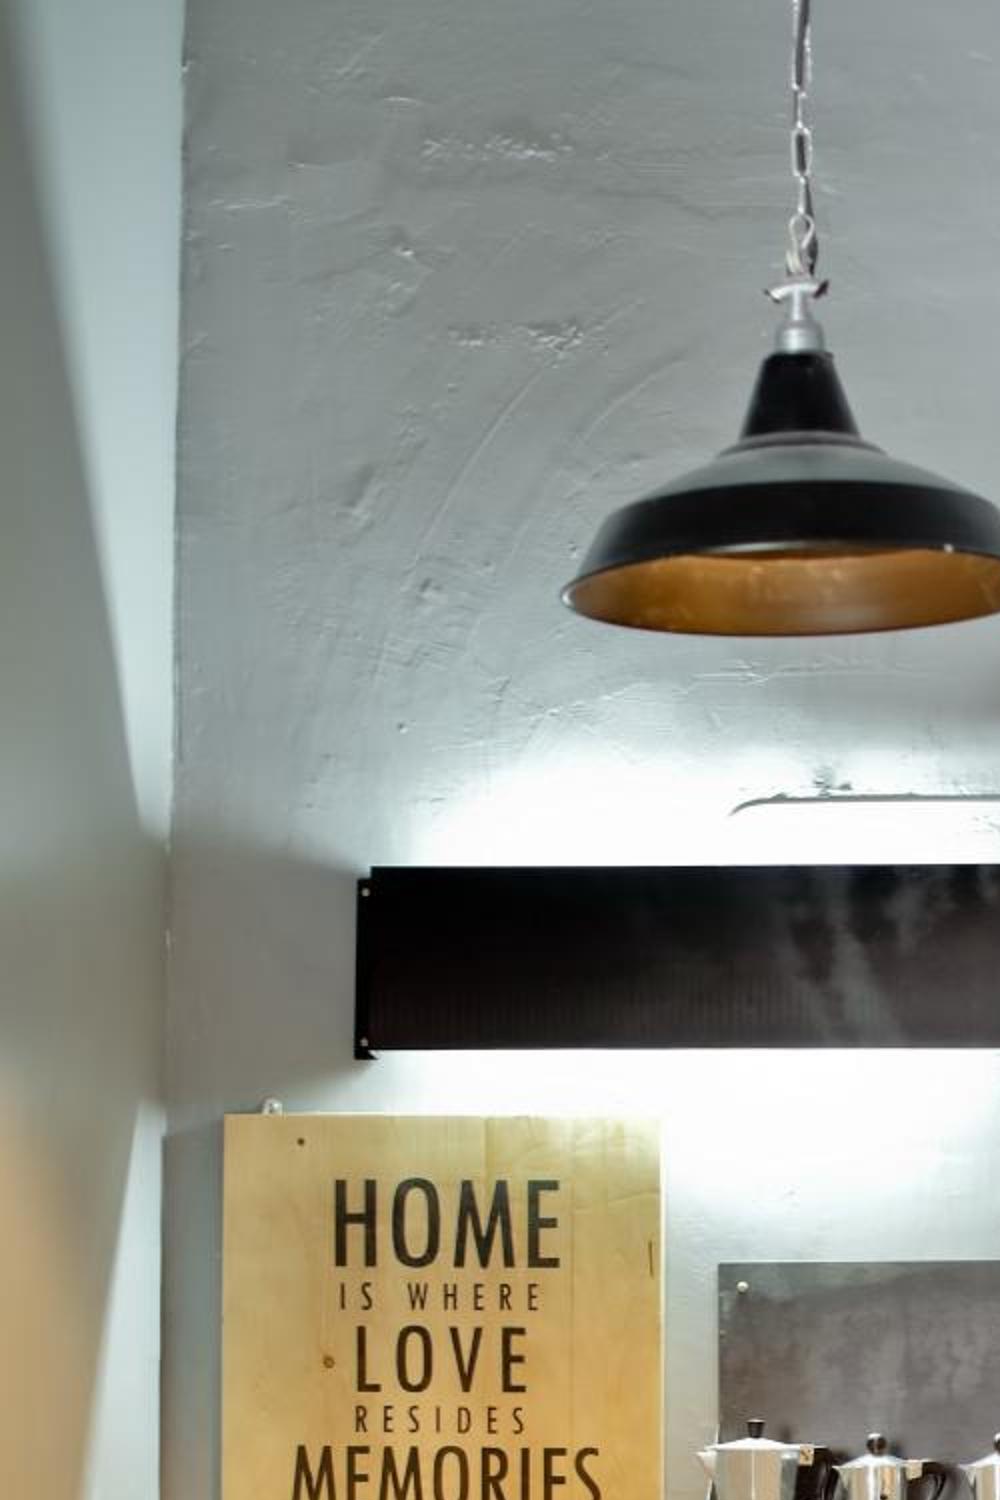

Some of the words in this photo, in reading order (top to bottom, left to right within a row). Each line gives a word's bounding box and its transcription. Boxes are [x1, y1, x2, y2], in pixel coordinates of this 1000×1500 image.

[333, 1177, 561, 1269] HOME
[339, 1282, 374, 1311] IS
[406, 1283, 539, 1311] WHERE
[355, 1325, 528, 1393] LOVE
[354, 1405, 524, 1435] RESIDES
